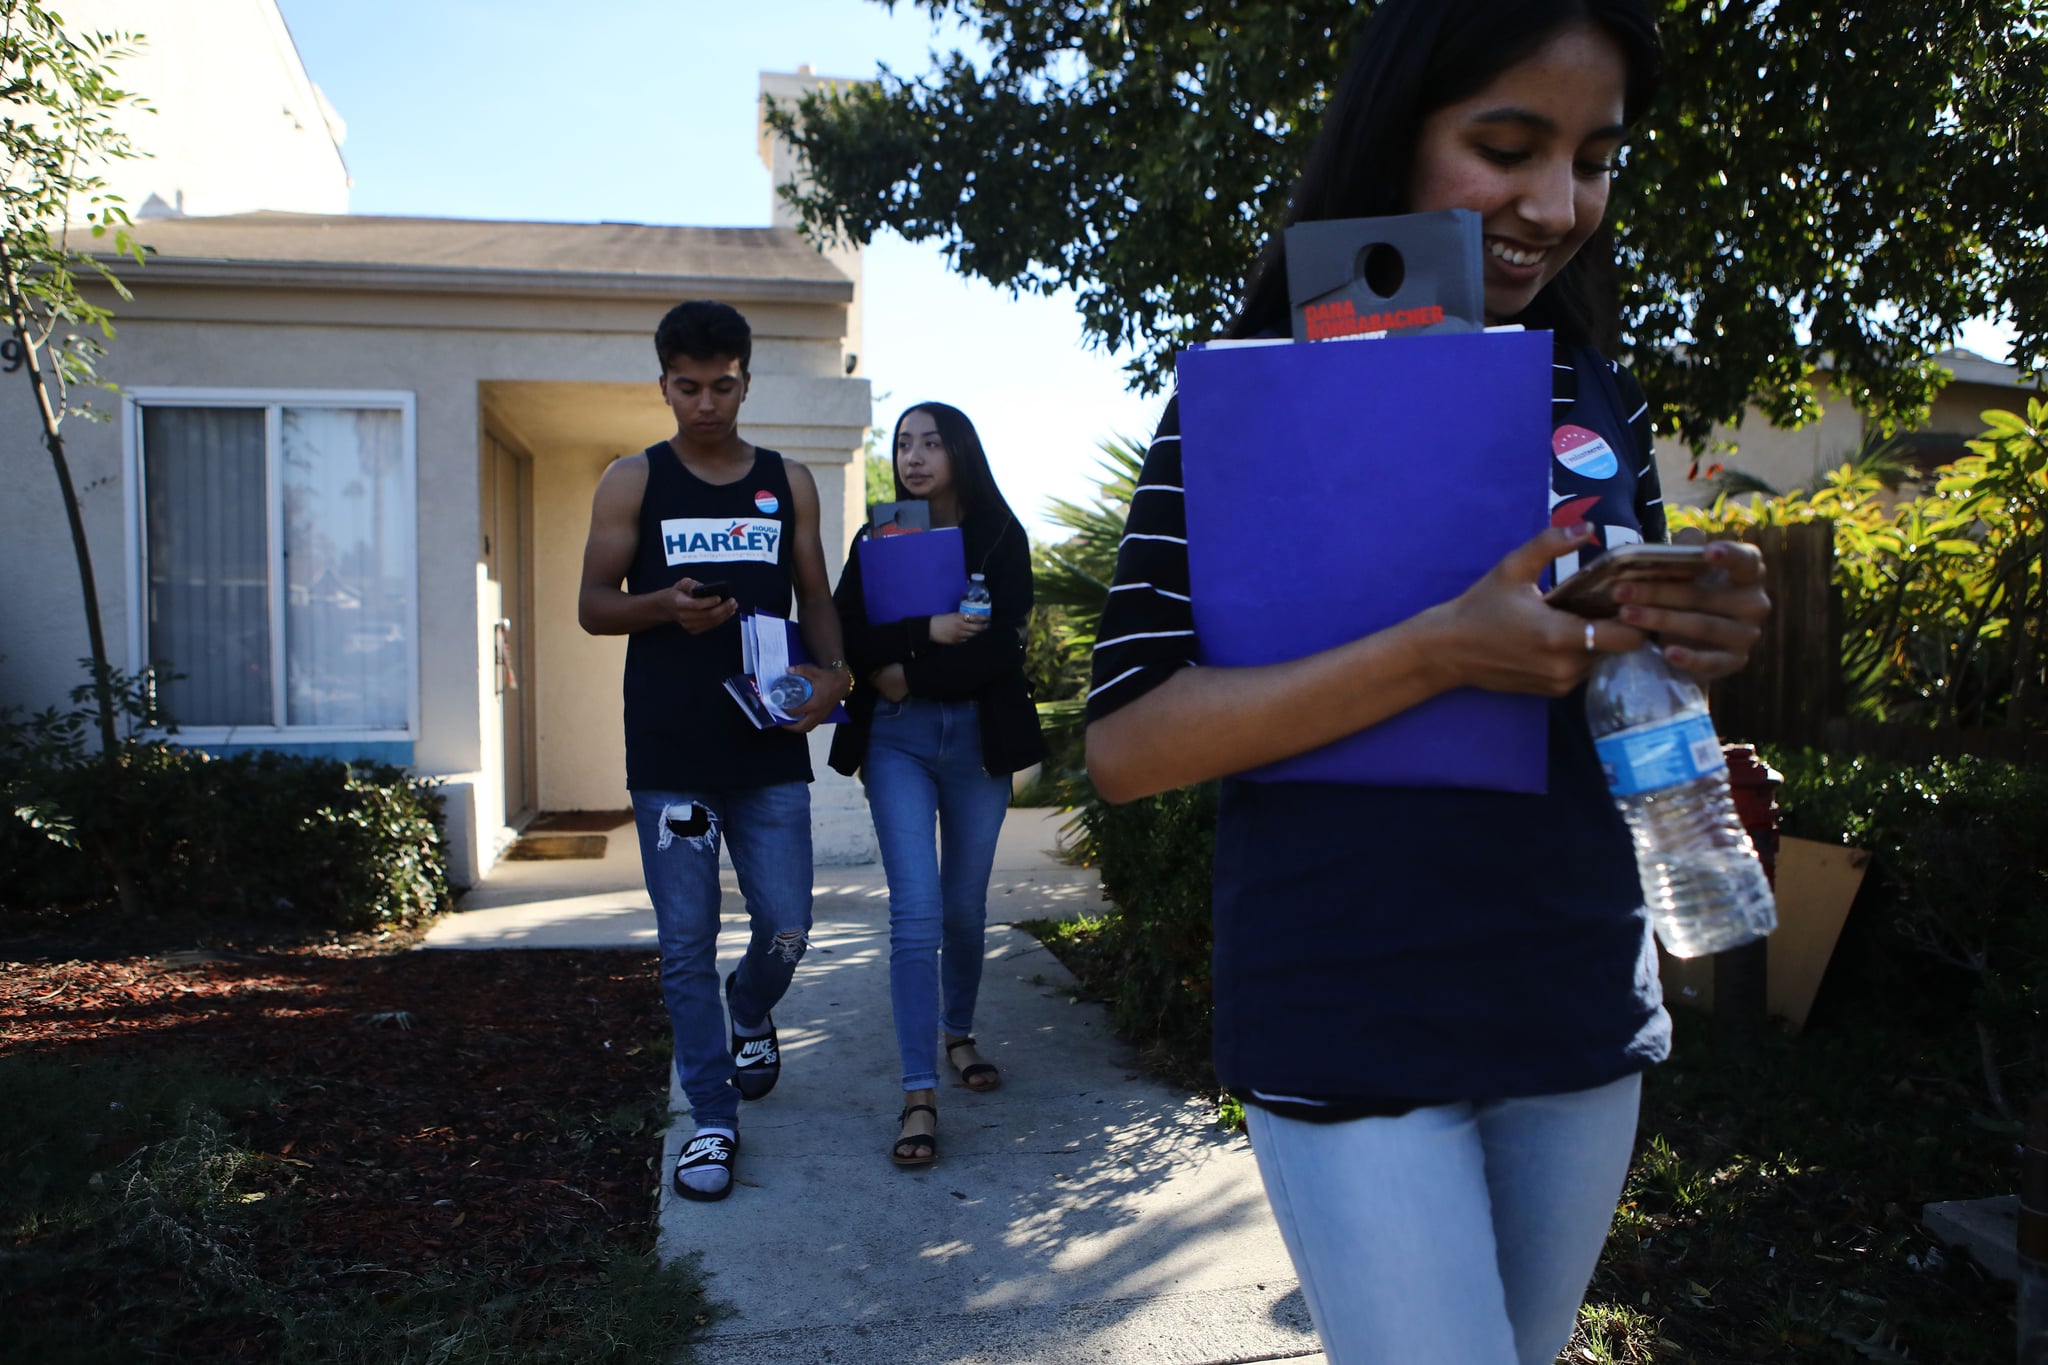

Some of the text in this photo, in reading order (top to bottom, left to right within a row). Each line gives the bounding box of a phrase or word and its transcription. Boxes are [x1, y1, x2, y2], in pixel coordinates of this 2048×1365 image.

[1304, 300, 1355, 320] DANA
[1306, 305, 1444, 339] ROHRABACHER
[1, 339, 23, 373] 9
[665, 532, 778, 555] HARLEY
[742, 1038, 772, 1055] NIKE
[764, 1052, 777, 1064] SB
[686, 1137, 724, 1154] NIKE
[708, 1150, 728, 1161] SB
